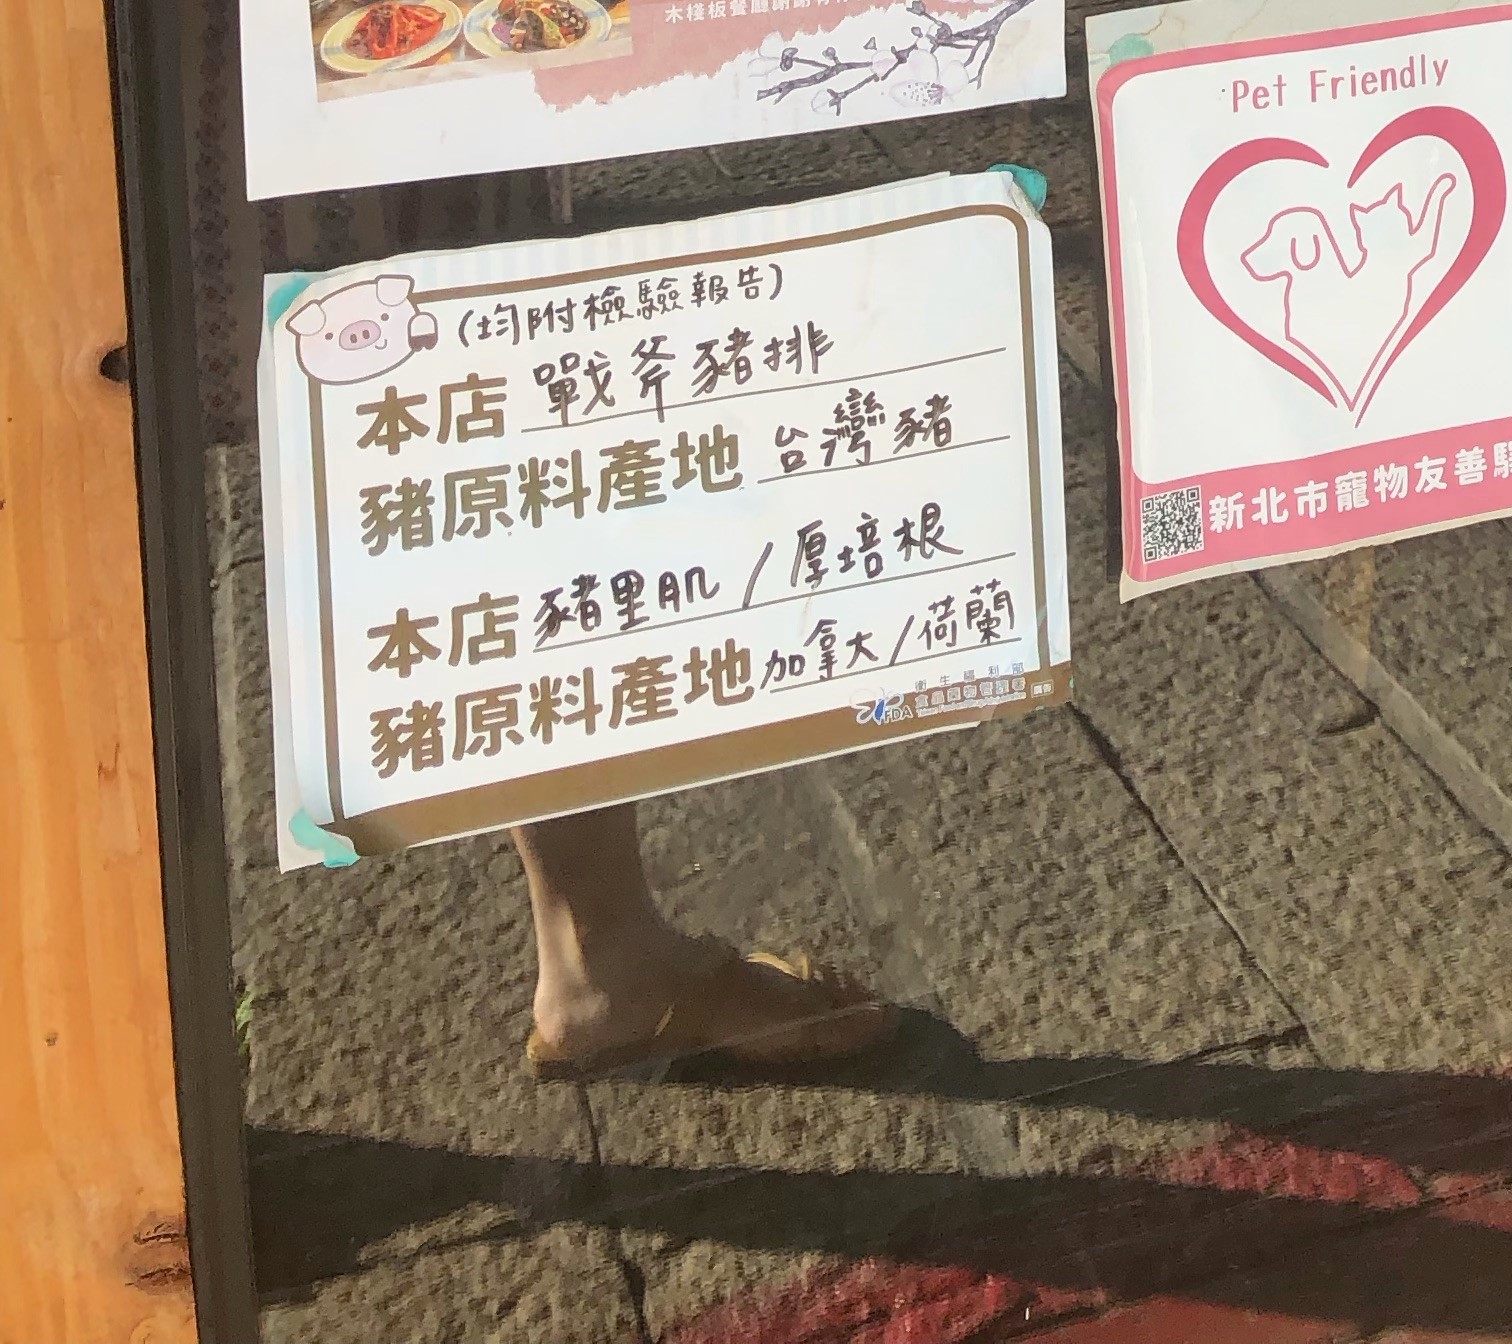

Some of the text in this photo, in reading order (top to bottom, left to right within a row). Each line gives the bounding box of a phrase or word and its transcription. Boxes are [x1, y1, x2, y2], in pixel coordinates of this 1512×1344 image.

[1231, 53, 1451, 114] Pet Friendly
[356, 372, 508, 456] 本店
[359, 388, 954, 557] 豬原料產地 台灣豬
[366, 591, 519, 679] 本店
[369, 638, 755, 781] 豬原料產地
